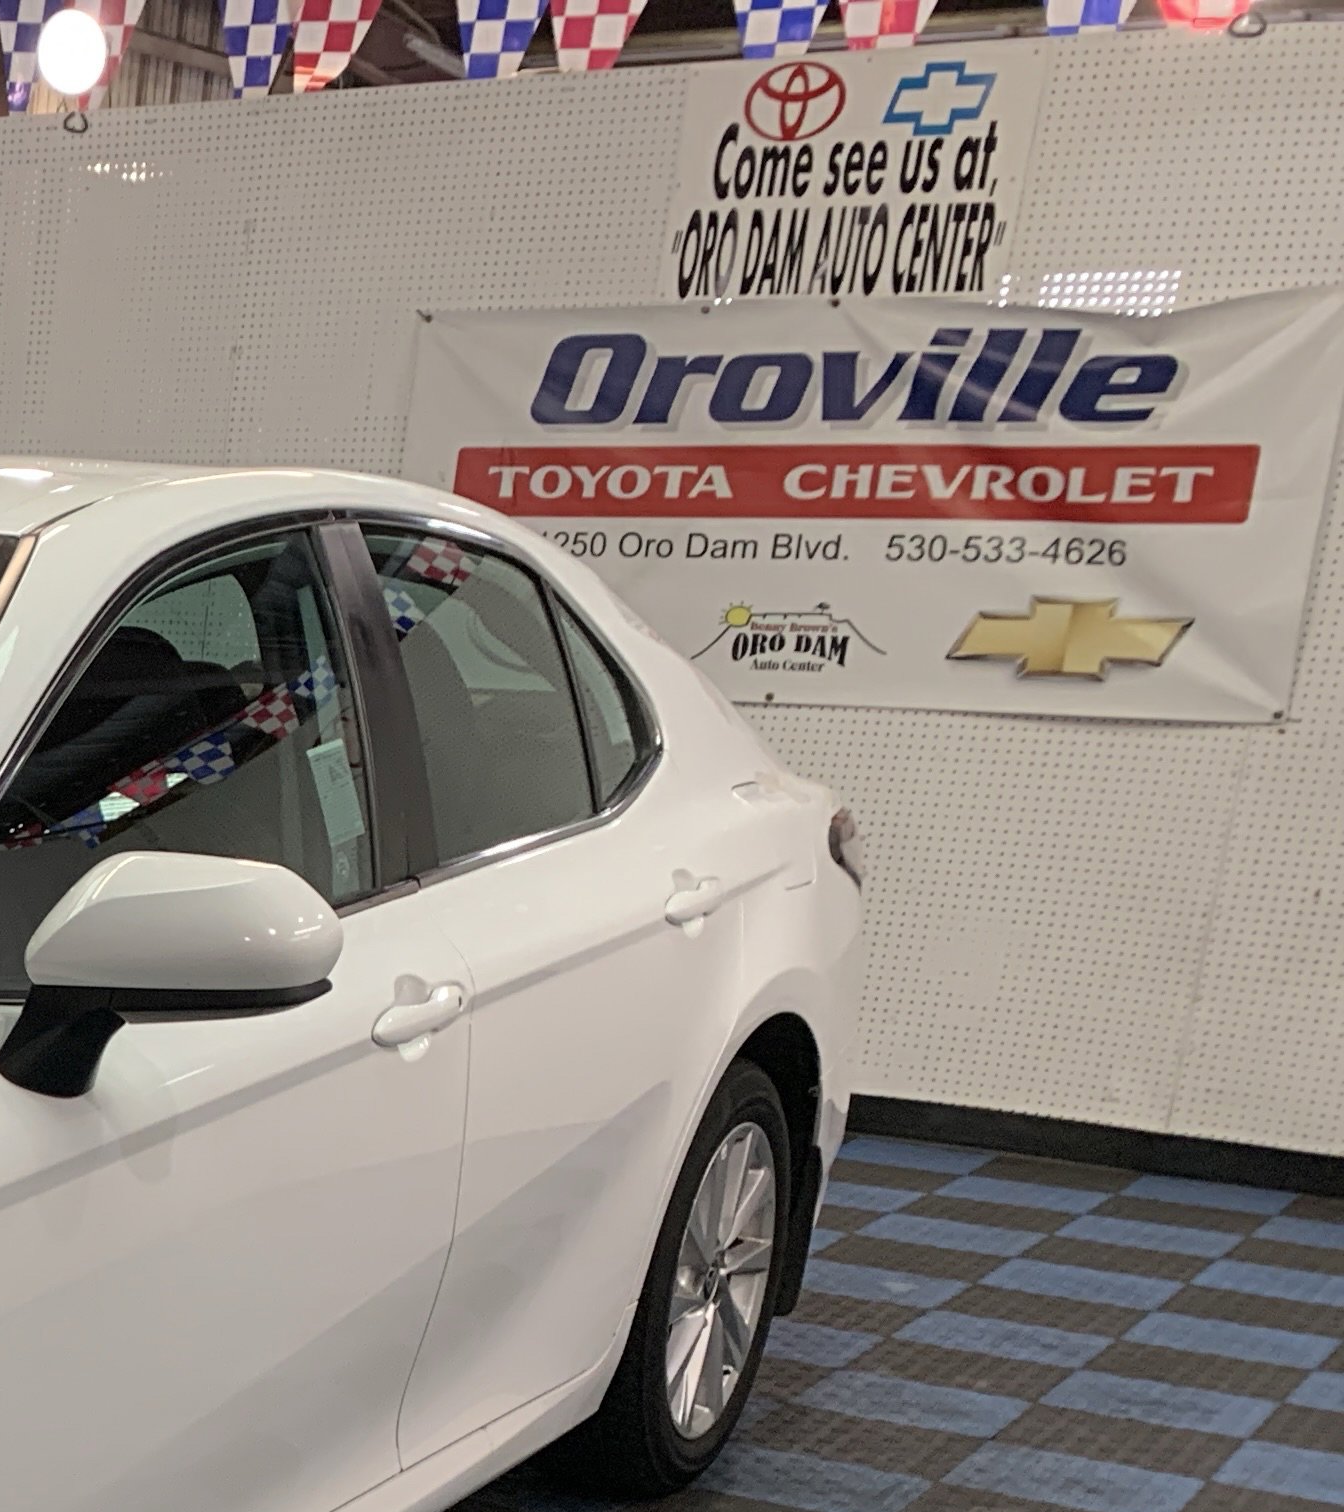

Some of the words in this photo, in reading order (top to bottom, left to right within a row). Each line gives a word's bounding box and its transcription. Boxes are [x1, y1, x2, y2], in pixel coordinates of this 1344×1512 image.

[713, 122, 813, 200] Come
[823, 139, 888, 197] see
[899, 137, 944, 194] us
[953, 120, 998, 197] at,
[739, 207, 810, 296] DAM
[809, 202, 889, 296] AUTO
[892, 202, 1007, 295] CENTER"
[530, 327, 1180, 424] Oroville
[488, 464, 734, 499] TOYOTA
[782, 464, 1215, 505] CHEVROLET
[618, 531, 674, 560] Oro
[685, 532, 759, 561] Dam
[770, 532, 850, 562] Blvd.
[885, 534, 1127, 567] 530-533-4626
[731, 632, 786, 662] ORO
[793, 634, 850, 667] DAM
[750, 659, 779, 671] Auto
[782, 659, 825, 672] Center
